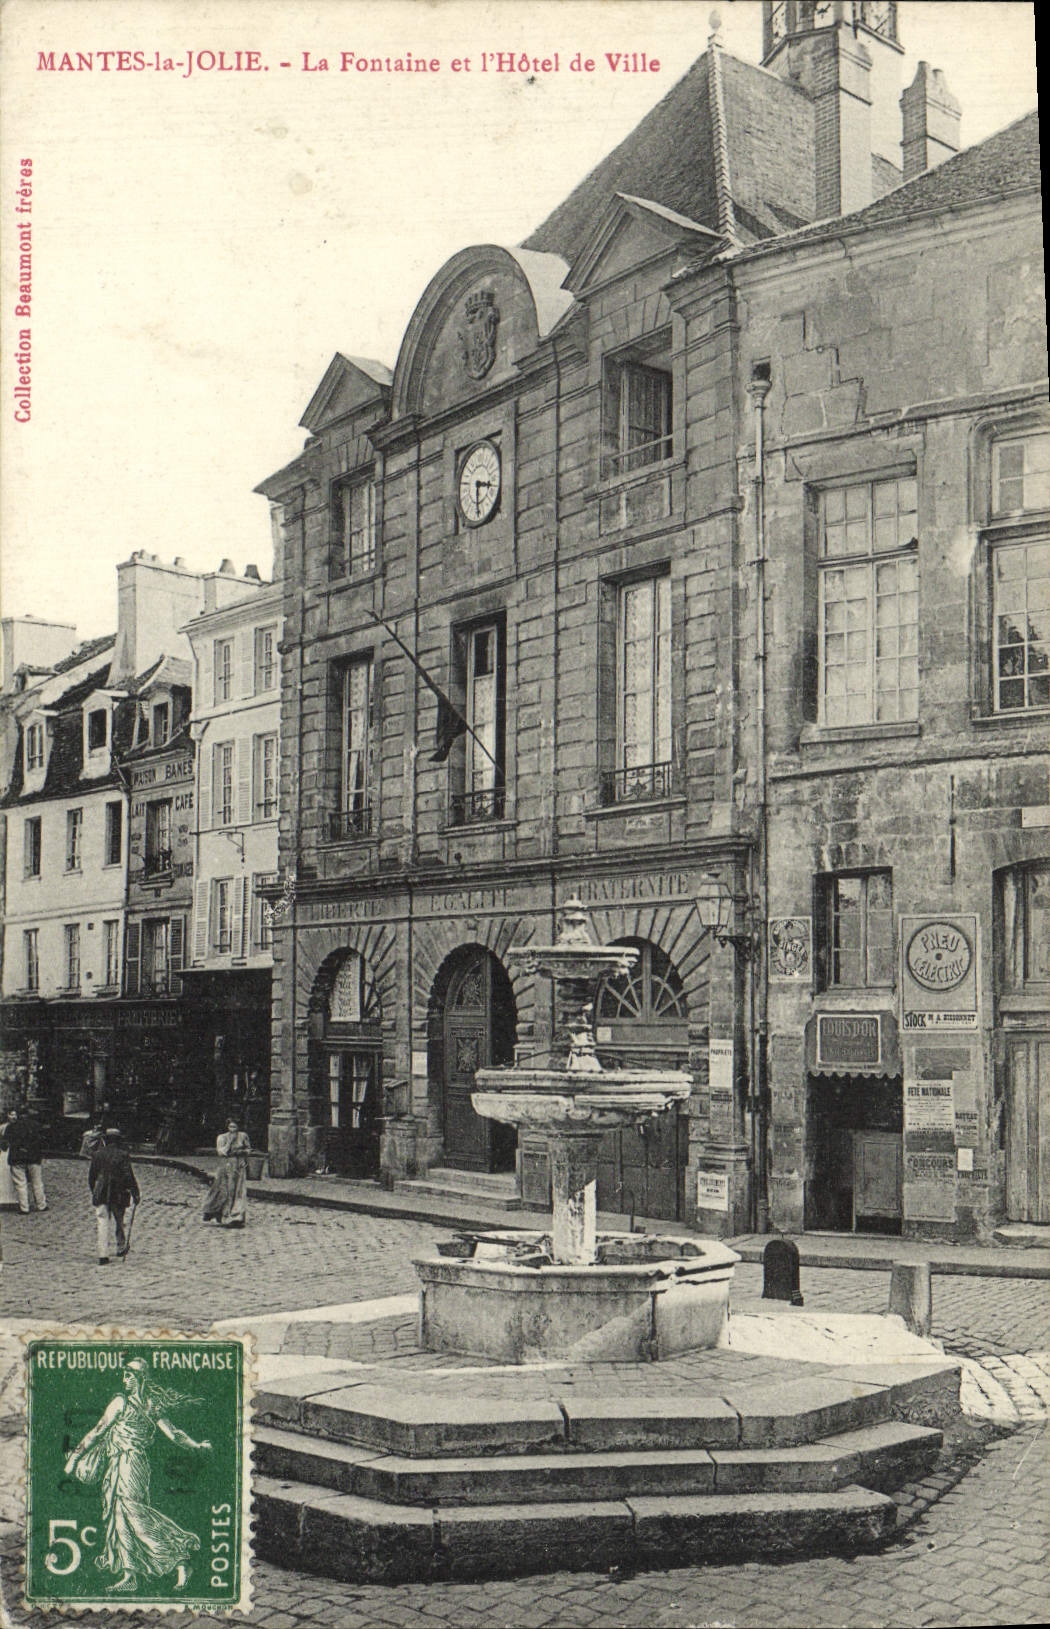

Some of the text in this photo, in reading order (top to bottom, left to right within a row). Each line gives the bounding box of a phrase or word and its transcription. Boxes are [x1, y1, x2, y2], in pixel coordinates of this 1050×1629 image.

[175, 792, 194, 811] CAFÉ
[921, 930, 960, 953] PNEU
[904, 1012, 927, 1028] STOCK
[37, 1350, 234, 1372] REPUBLIQUE FRANÇAISE
[211, 1503, 231, 1588] POSTES
